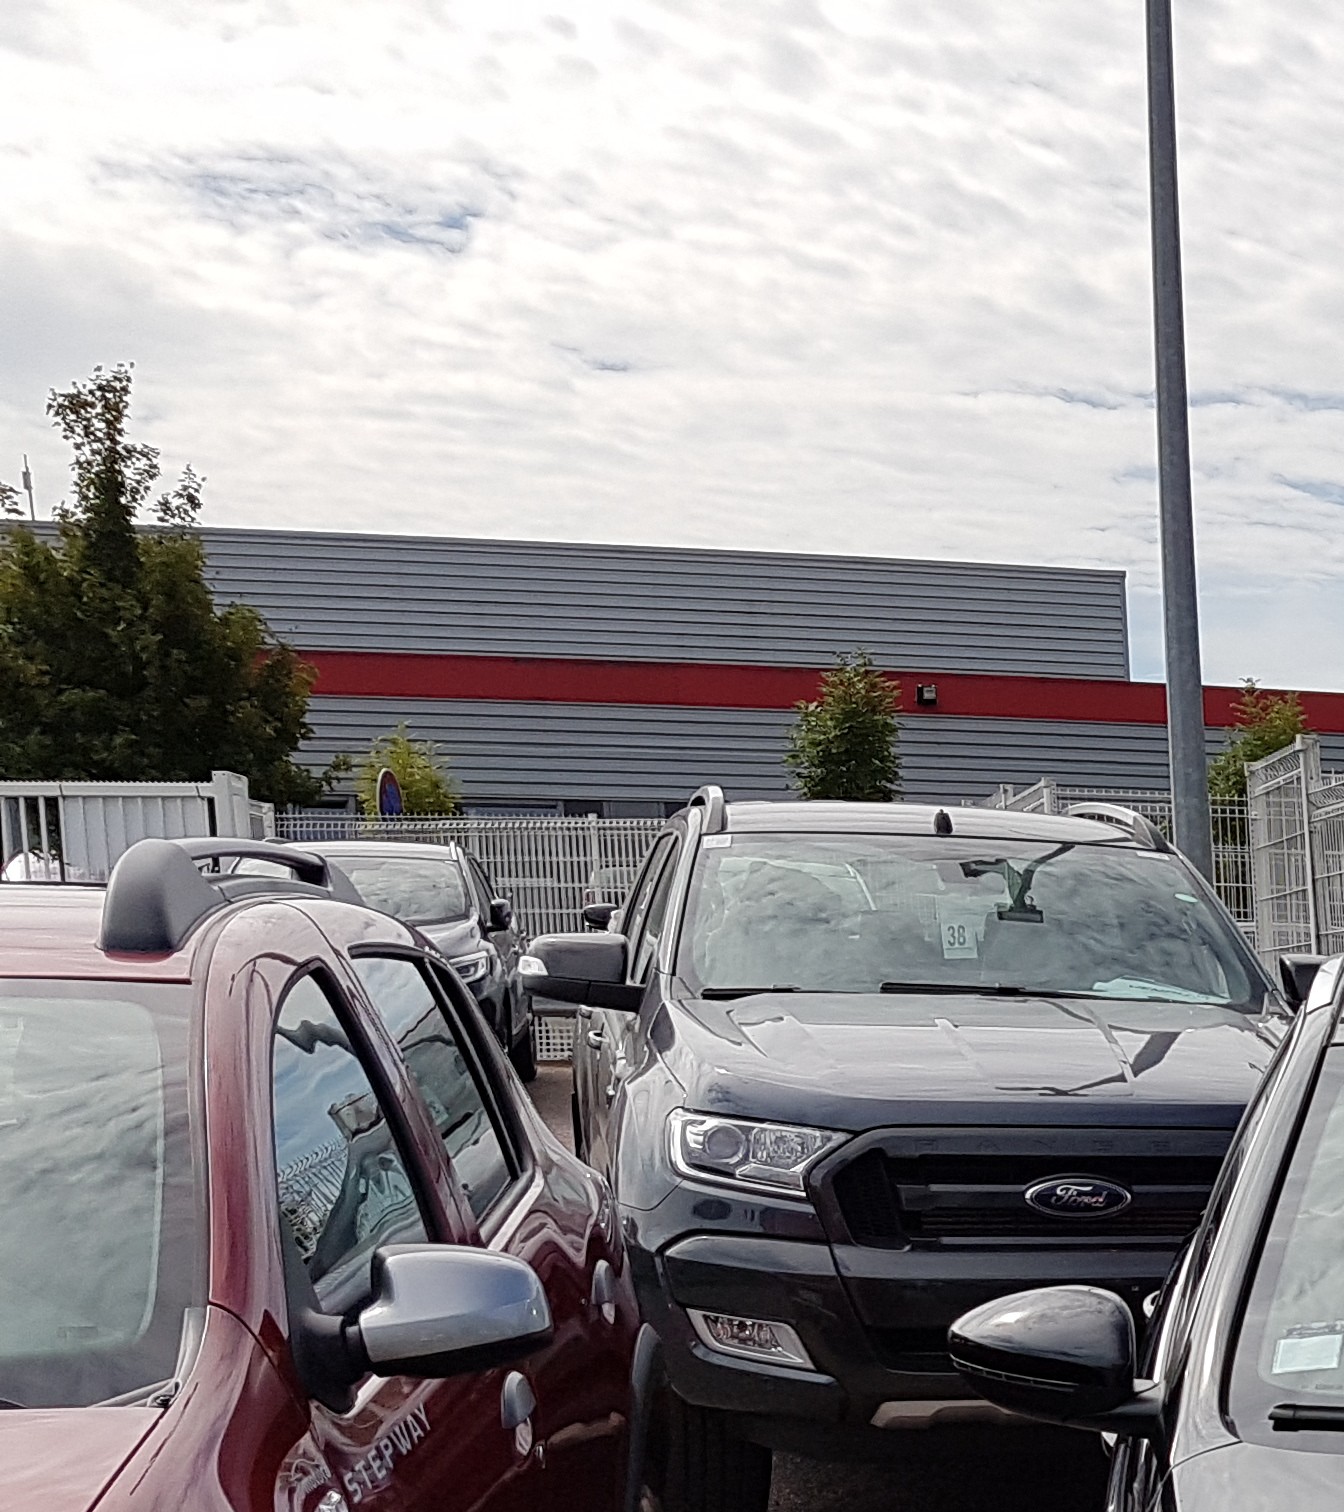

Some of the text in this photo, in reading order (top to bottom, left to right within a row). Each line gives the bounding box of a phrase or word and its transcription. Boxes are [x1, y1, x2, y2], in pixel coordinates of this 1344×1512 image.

[947, 924, 967, 947] 38
[1051, 1183, 1108, 1208] Ford
[343, 1402, 431, 1504] STEPWAY
